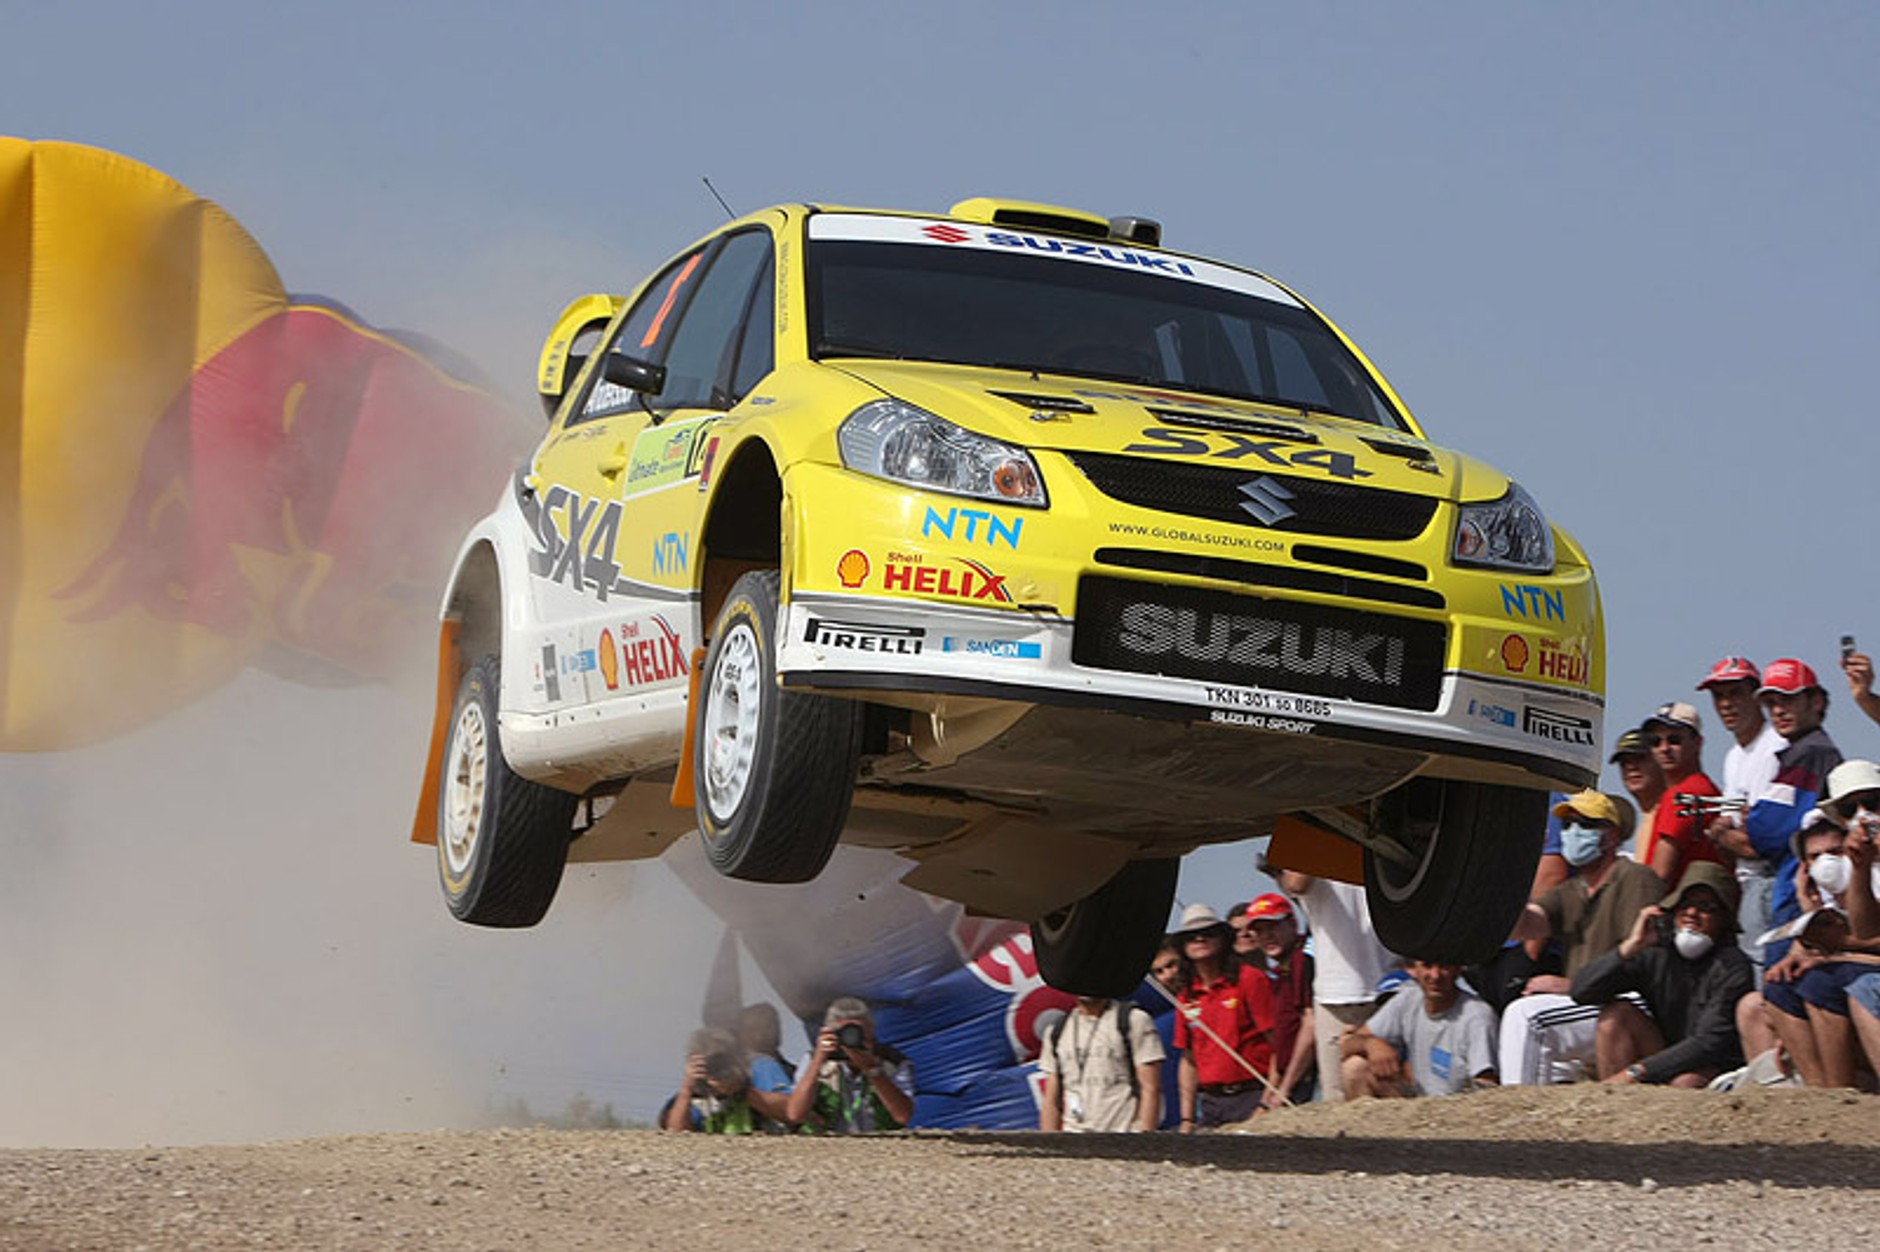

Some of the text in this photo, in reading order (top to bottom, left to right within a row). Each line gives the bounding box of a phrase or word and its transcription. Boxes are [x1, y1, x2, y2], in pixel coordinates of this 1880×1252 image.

[985, 232, 1195, 277] SUZUKI
[1123, 427, 1374, 480] SX4
[528, 485, 622, 602] SX4
[922, 506, 1024, 549] NTN
[1109, 523, 1285, 551] WWW.GLOBALSUZUKI.COM
[653, 531, 689, 577] NTN
[887, 552, 923, 563] Shell
[884, 558, 1013, 602] HELIX
[1500, 583, 1566, 622] NTN
[623, 622, 689, 686] HELIX
[804, 618, 926, 655] PIRELLI
[1118, 602, 1404, 686] SUZUKI
[1539, 648, 1589, 685] HELIX
[1205, 686, 1240, 704] TKN
[1210, 710, 1316, 733] SUZUKI SPORT
[1523, 705, 1594, 746] PIRELLI
